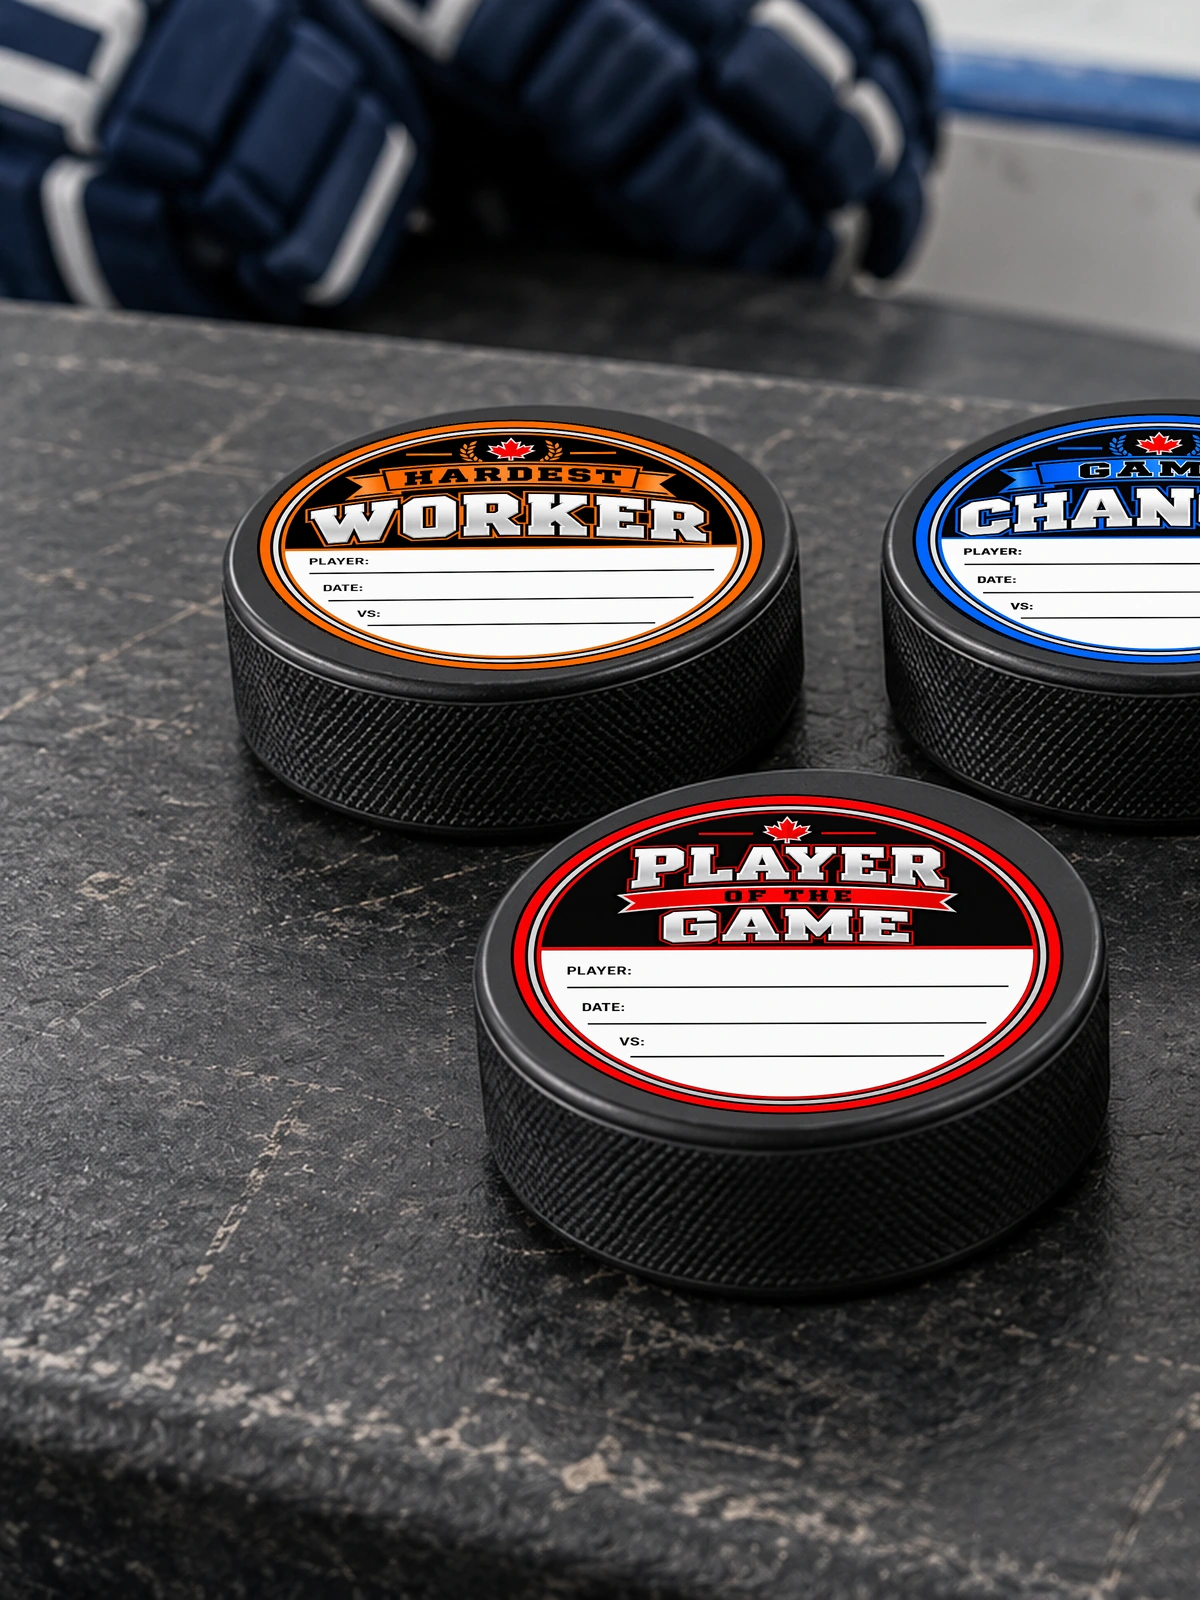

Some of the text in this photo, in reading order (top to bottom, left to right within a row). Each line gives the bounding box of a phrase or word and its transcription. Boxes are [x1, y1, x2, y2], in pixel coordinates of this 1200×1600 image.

[404, 466, 622, 486] HARDEST
[310, 493, 708, 545] WORKER
[963, 547, 1022, 556] PLAYER:
[309, 557, 369, 566] PLAYER:
[977, 575, 1017, 584] DATE:
[323, 583, 363, 592] DATE:
[1010, 602, 1033, 611] VS:
[357, 609, 380, 618] VS:
[631, 847, 946, 889] PLAYER
[725, 890, 853, 903] OF THE
[663, 910, 911, 944] GAME
[567, 965, 632, 976] PLAYER:
[582, 1002, 625, 1012] DATE:
[619, 1036, 645, 1047] VS:
